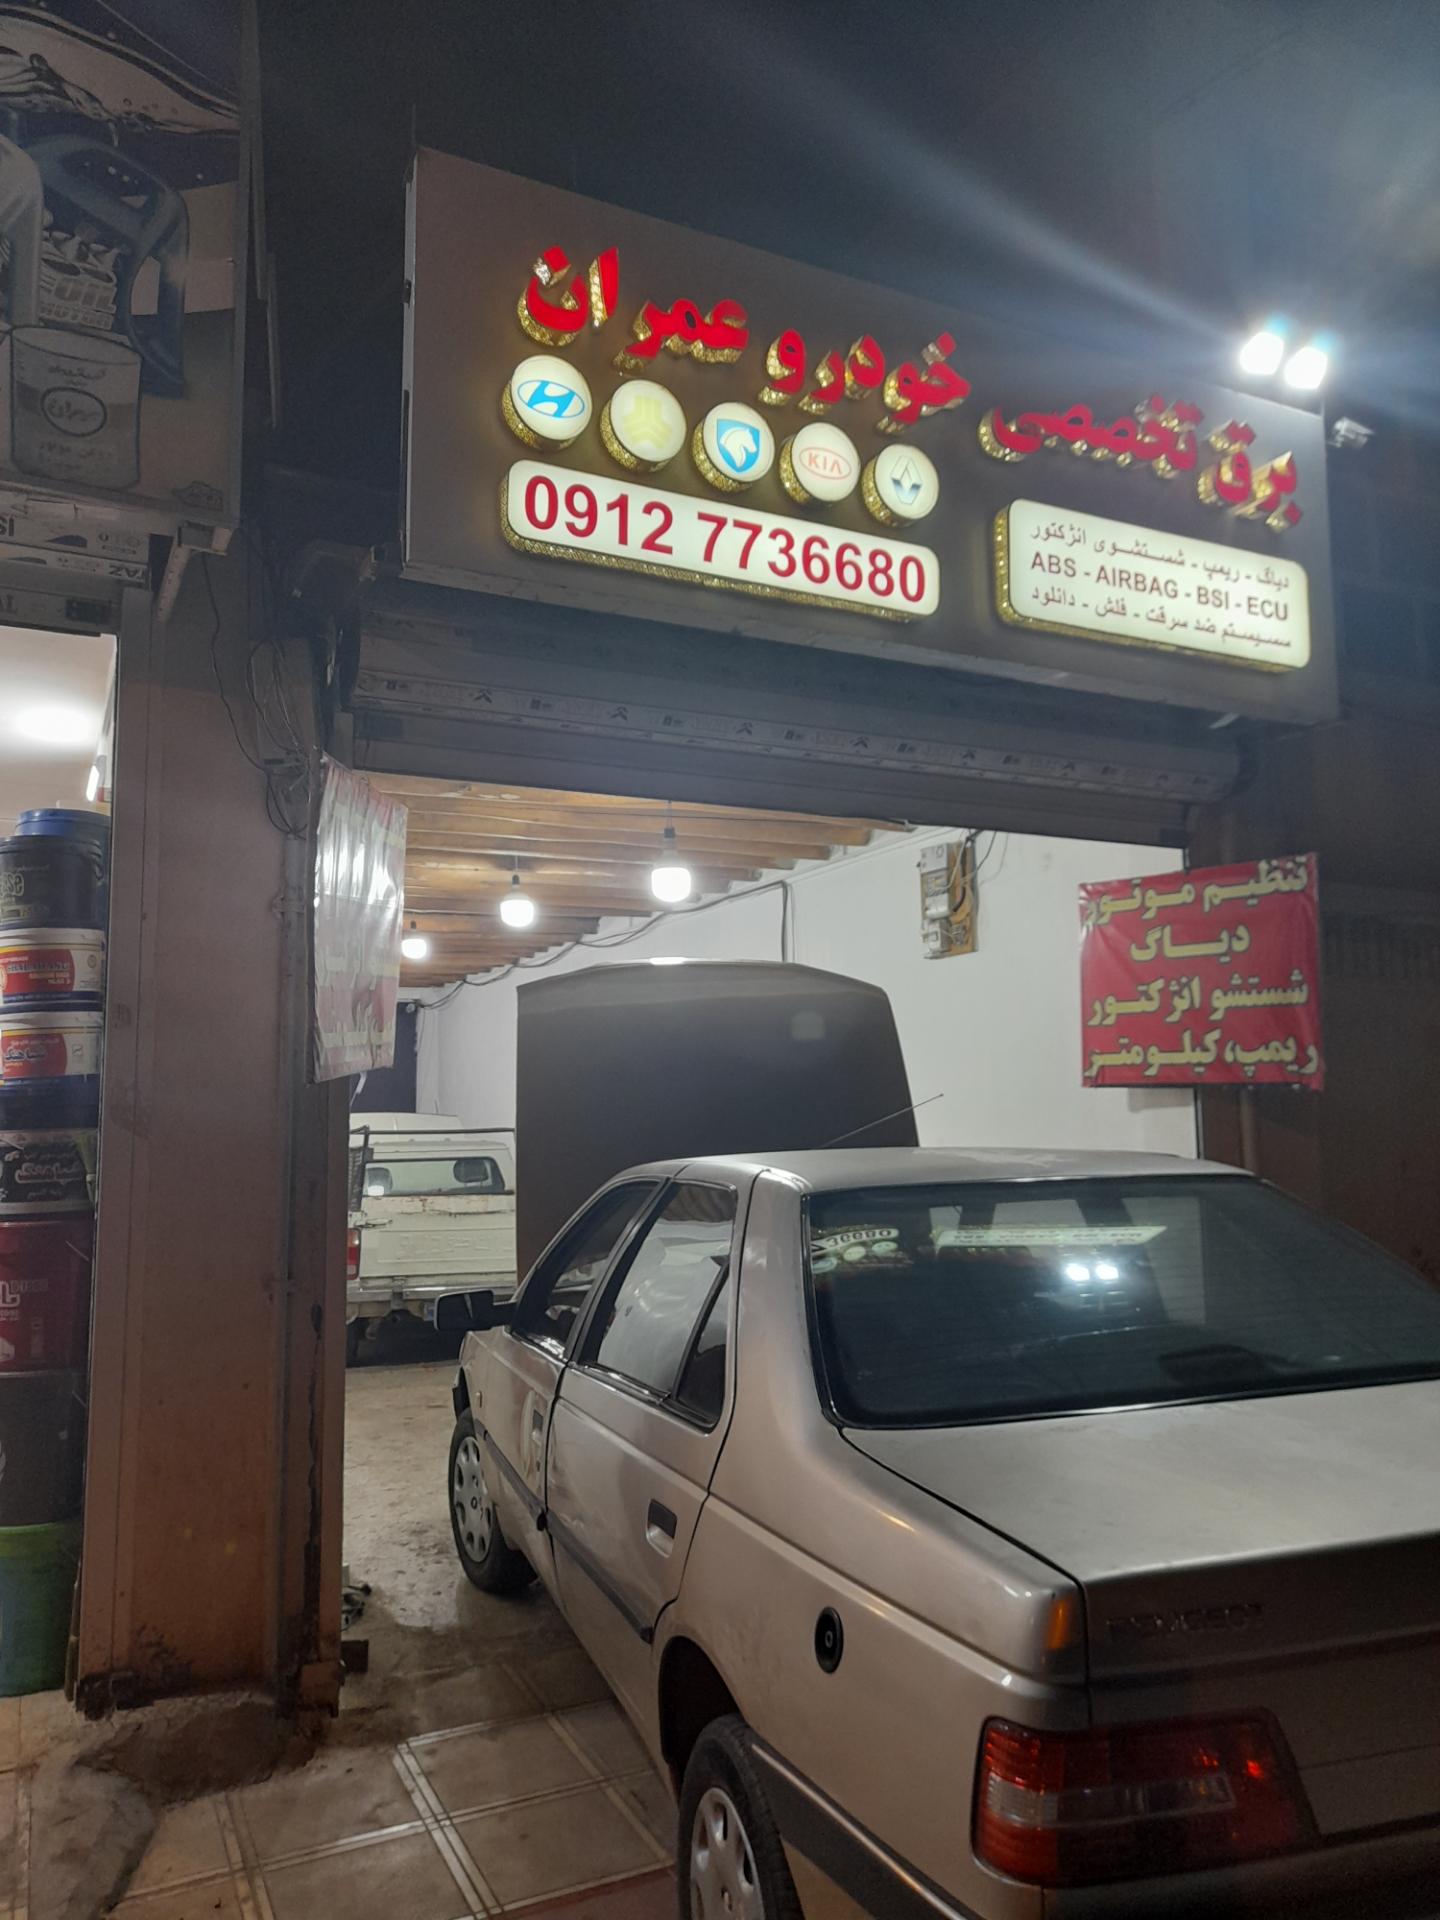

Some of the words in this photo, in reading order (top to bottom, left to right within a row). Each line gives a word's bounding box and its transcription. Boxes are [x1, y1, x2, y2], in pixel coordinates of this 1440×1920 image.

[521, 244, 750, 362] عمران
[770, 330, 972, 426] خودرو
[990, 395, 1202, 472] تخصصی
[806, 451, 845, 476] KIA
[1212, 418, 1302, 526] برق
[523, 475, 675, 556] 0912
[696, 510, 926, 603] 7736680
[1031, 551, 1077, 578] ABS
[1095, 565, 1179, 599] AIRBAG
[1197, 585, 1229, 610] BSI
[1247, 596, 1289, 621] ECU
[1032, 585, 1076, 607] دانلود
[1085, 879, 1196, 928] موتور
[1202, 855, 1309, 913] تنظیم
[1130, 923, 1251, 964] دیاگ
[1208, 968, 1309, 1022] شستشو
[1083, 1028, 1223, 1078] کیلومتر
